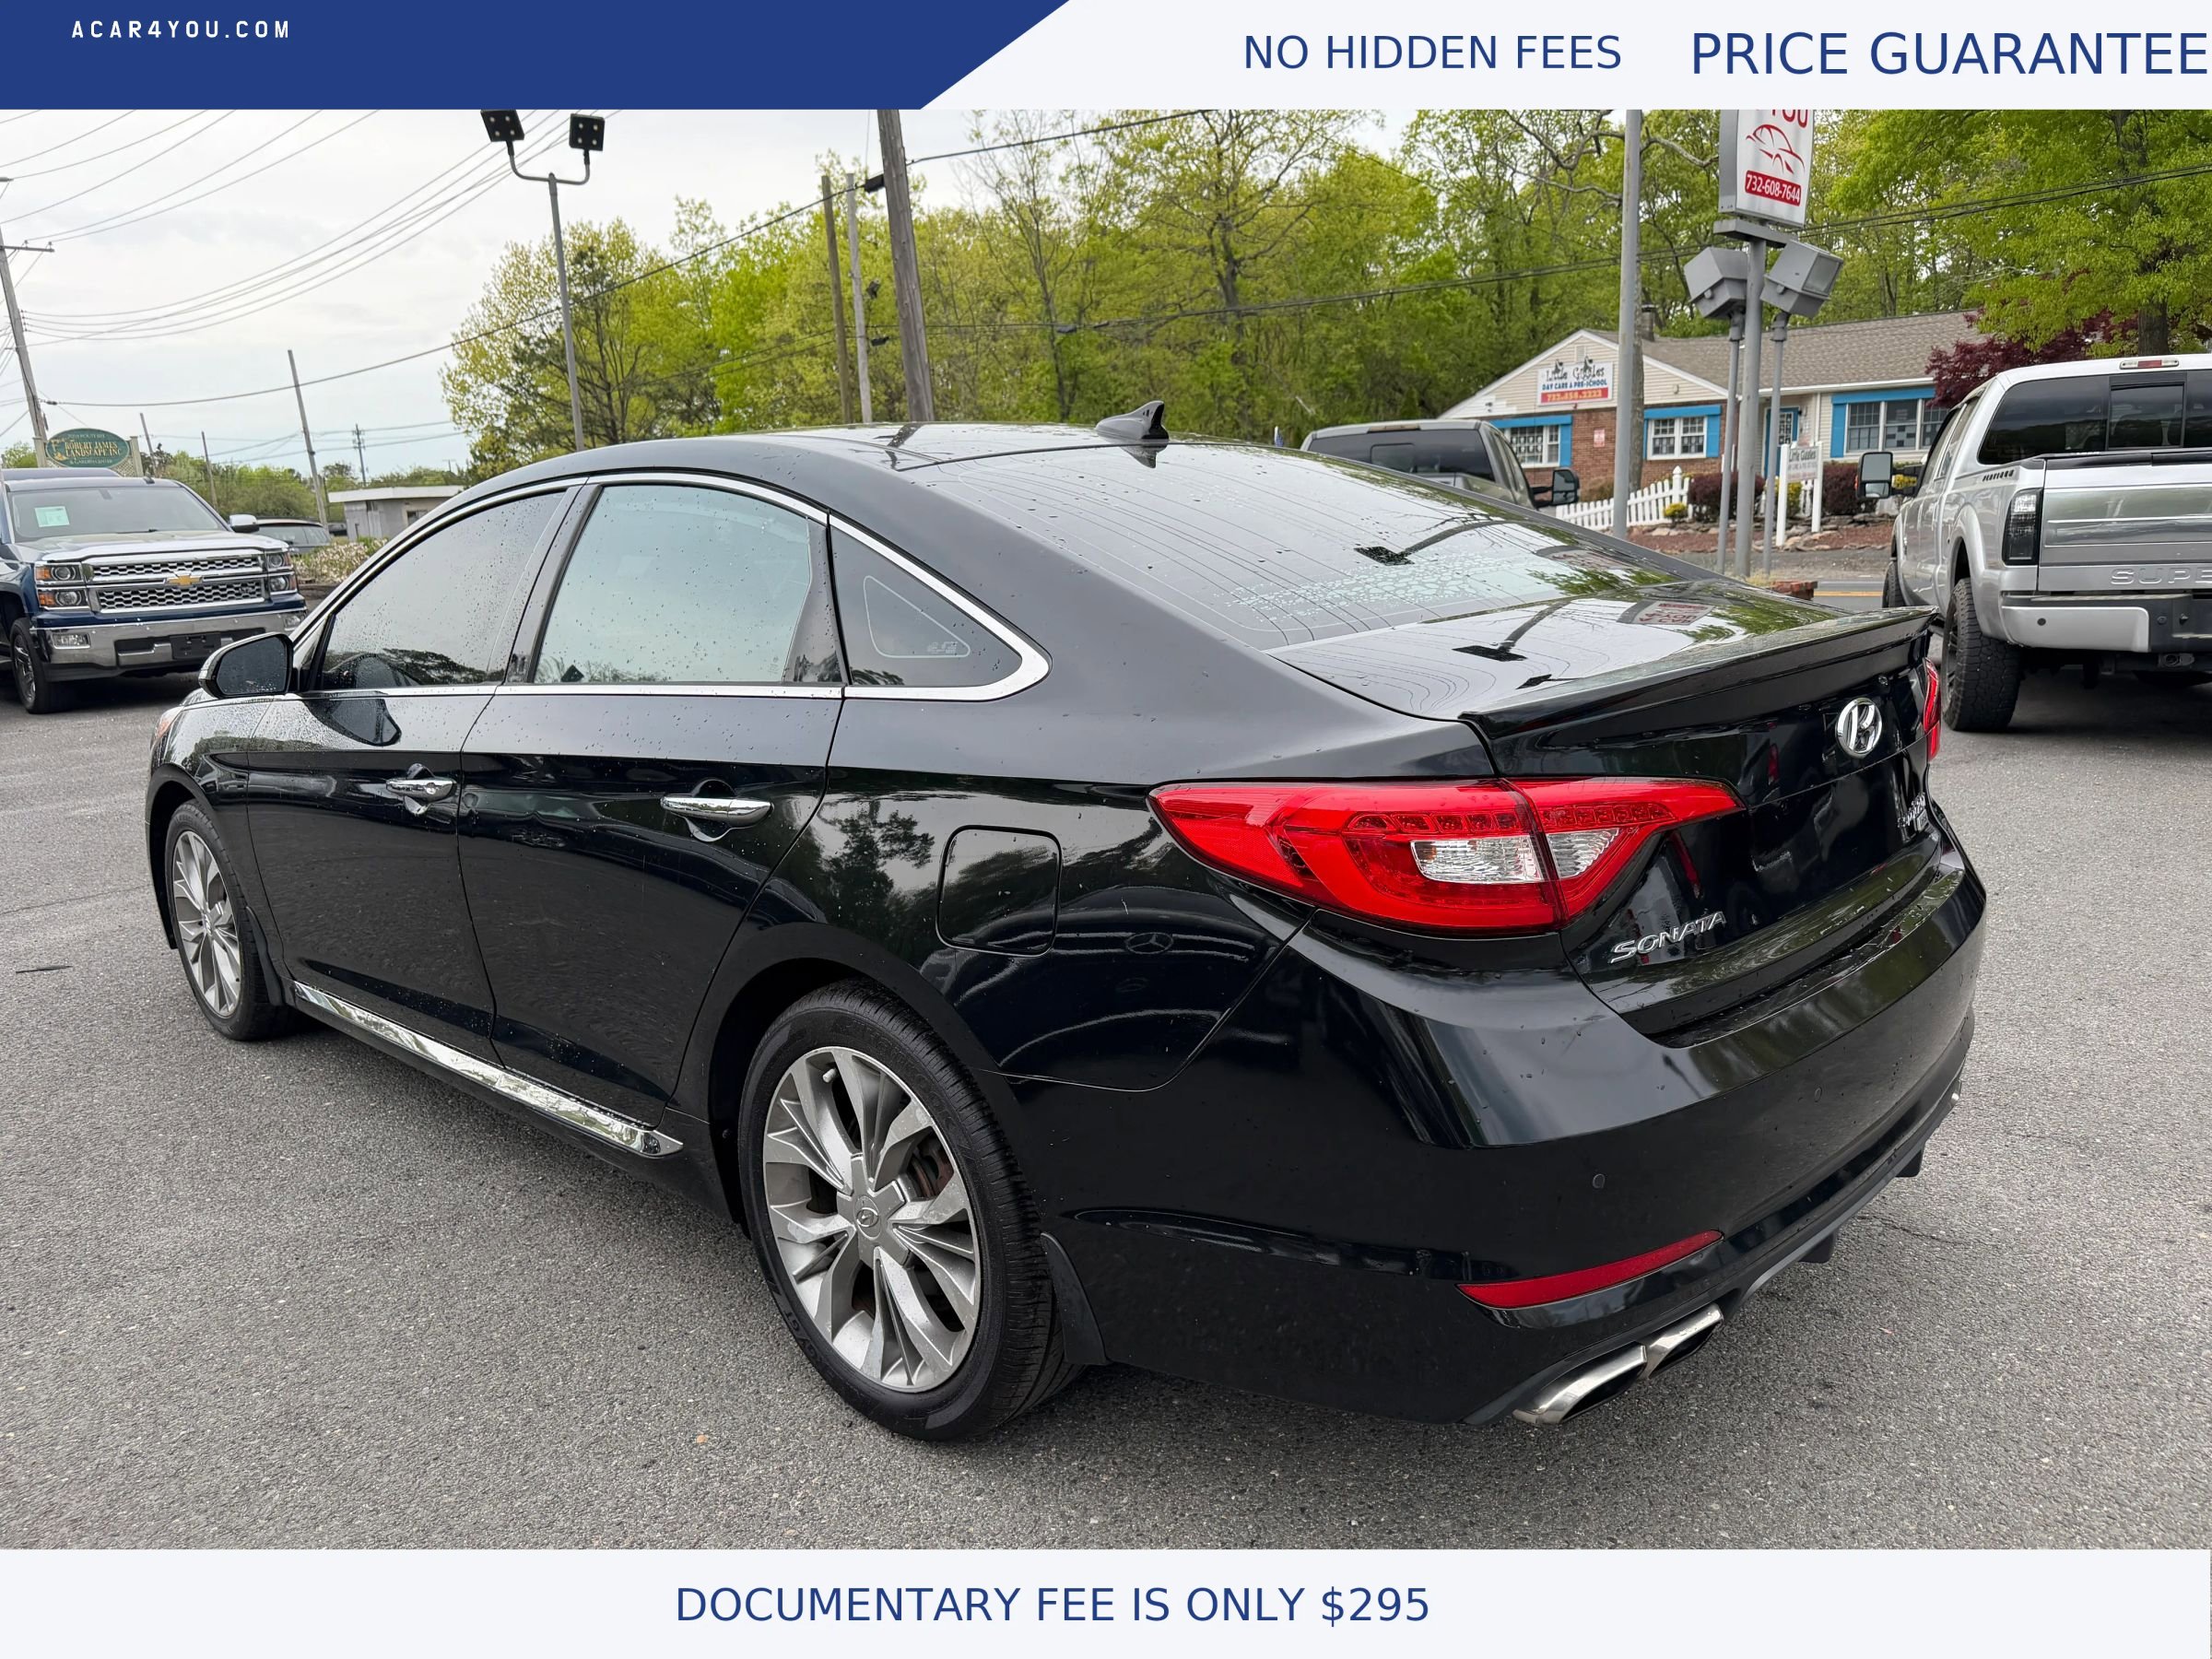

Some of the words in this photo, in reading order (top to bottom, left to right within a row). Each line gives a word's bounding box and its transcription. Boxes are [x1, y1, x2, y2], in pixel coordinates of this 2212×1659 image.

[1746, 173, 1801, 203] 732-608-7644
[1542, 382, 1554, 391] DAY
[1554, 382, 1568, 390] CARE
[1573, 379, 1607, 388] PRE-SCHOOL
[65, 441, 92, 450] ROBERT
[95, 441, 118, 450] JAMES
[65, 448, 106, 457] LANDSCAPE
[1608, 911, 1726, 964] SONATA
